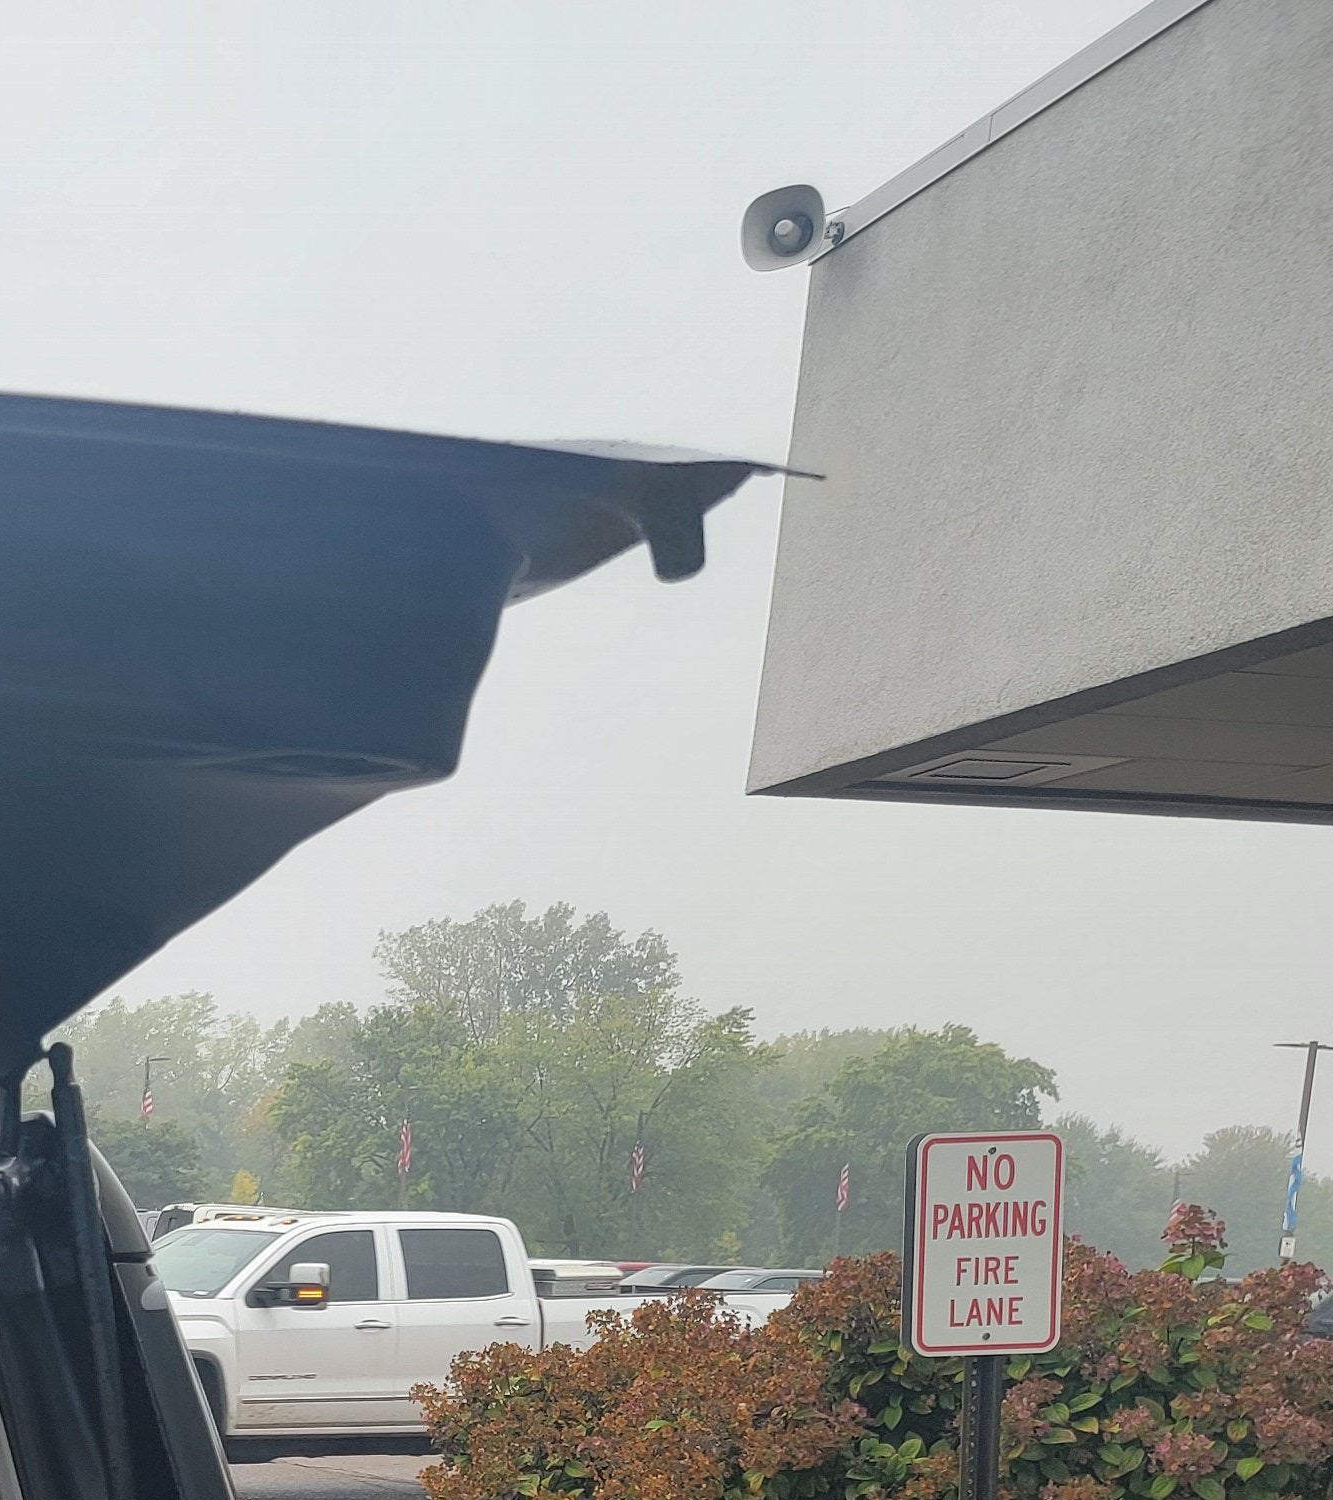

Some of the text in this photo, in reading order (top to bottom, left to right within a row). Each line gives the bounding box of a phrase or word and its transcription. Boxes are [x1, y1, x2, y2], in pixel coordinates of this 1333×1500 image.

[966, 1153, 1016, 1191] NO
[932, 1200, 1047, 1240] PARKING
[955, 1255, 1019, 1287] FIRE
[949, 1296, 1024, 1328] LANE
